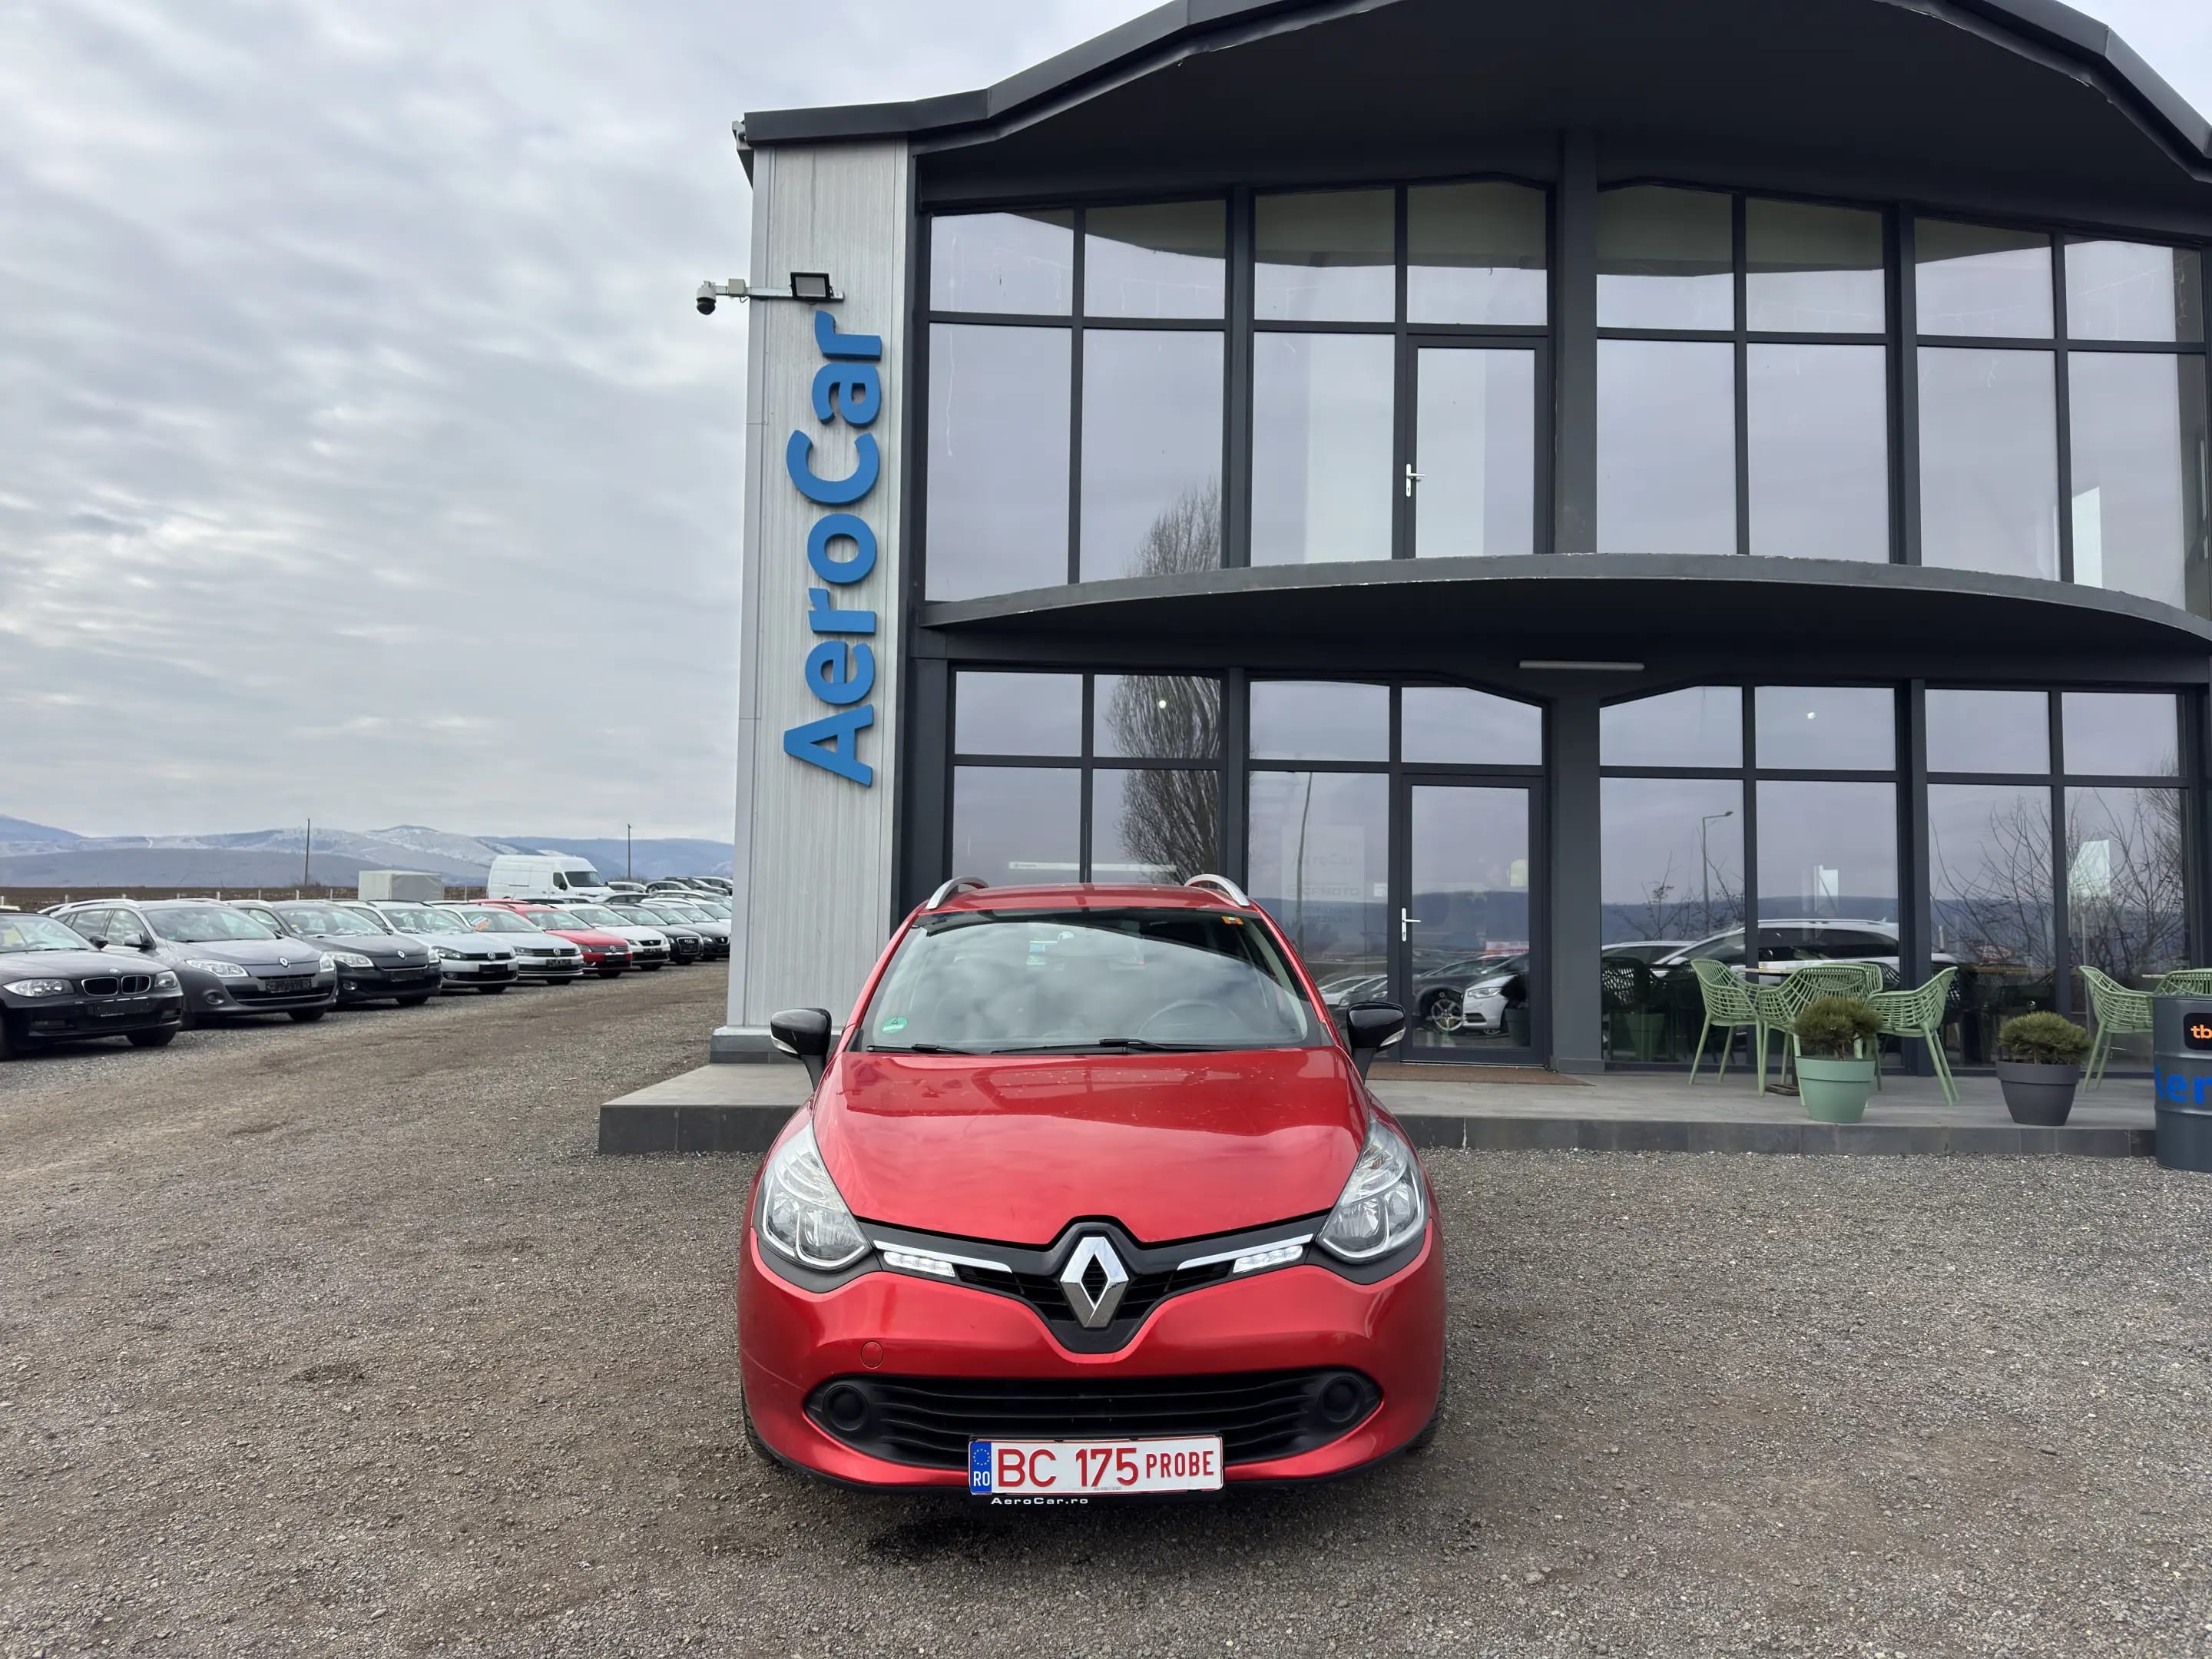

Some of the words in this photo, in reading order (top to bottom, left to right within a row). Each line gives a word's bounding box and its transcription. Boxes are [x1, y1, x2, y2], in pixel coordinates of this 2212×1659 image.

[783, 310, 882, 787] AeroCar
[973, 1471, 991, 1487] RO
[998, 1449, 1057, 1488] BC
[1075, 1448, 1139, 1488] 175
[1146, 1451, 1214, 1479] PROBE
[991, 1497, 1088, 1505] AeroCar.ro
